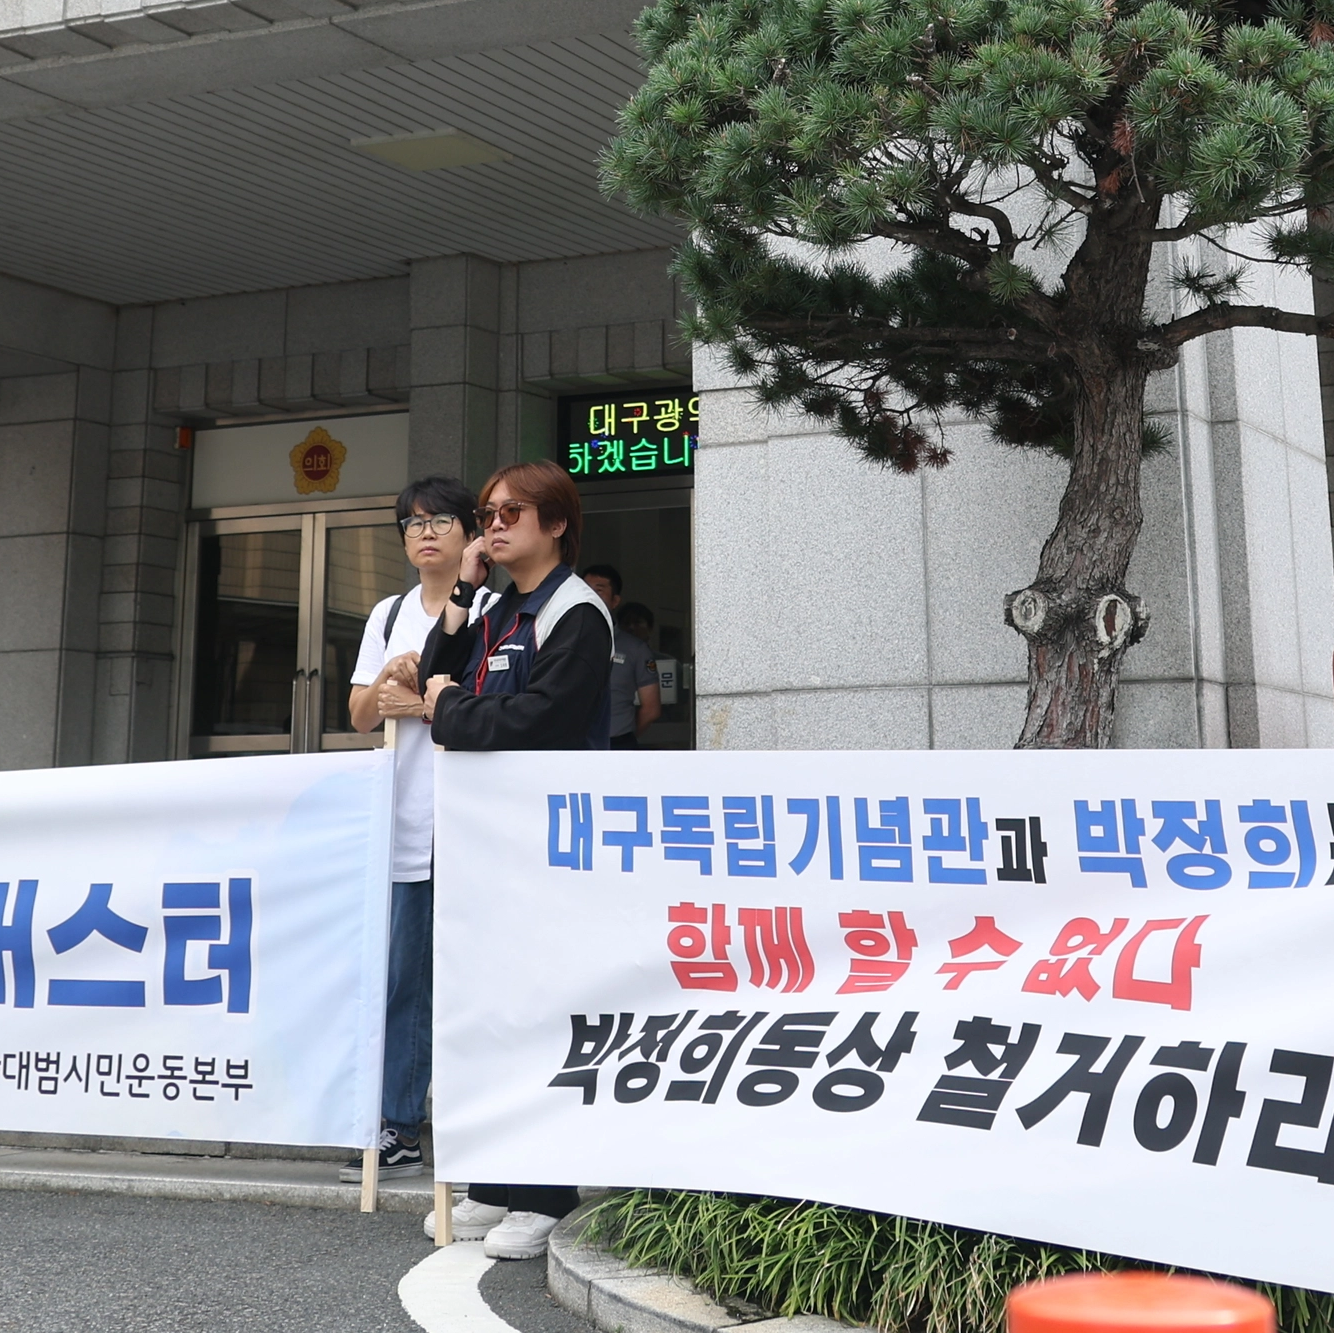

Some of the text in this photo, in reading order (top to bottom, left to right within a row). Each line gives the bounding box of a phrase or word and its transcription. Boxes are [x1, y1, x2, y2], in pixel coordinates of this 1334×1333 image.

[303, 453, 332, 471] 의회
[569, 437, 699, 475] 하겠습니
[548, 793, 1047, 884] 대구독립기념관과
[667, 902, 1209, 1011] 함께 할 수 없다
[546, 1010, 919, 1112] 박정희동상
